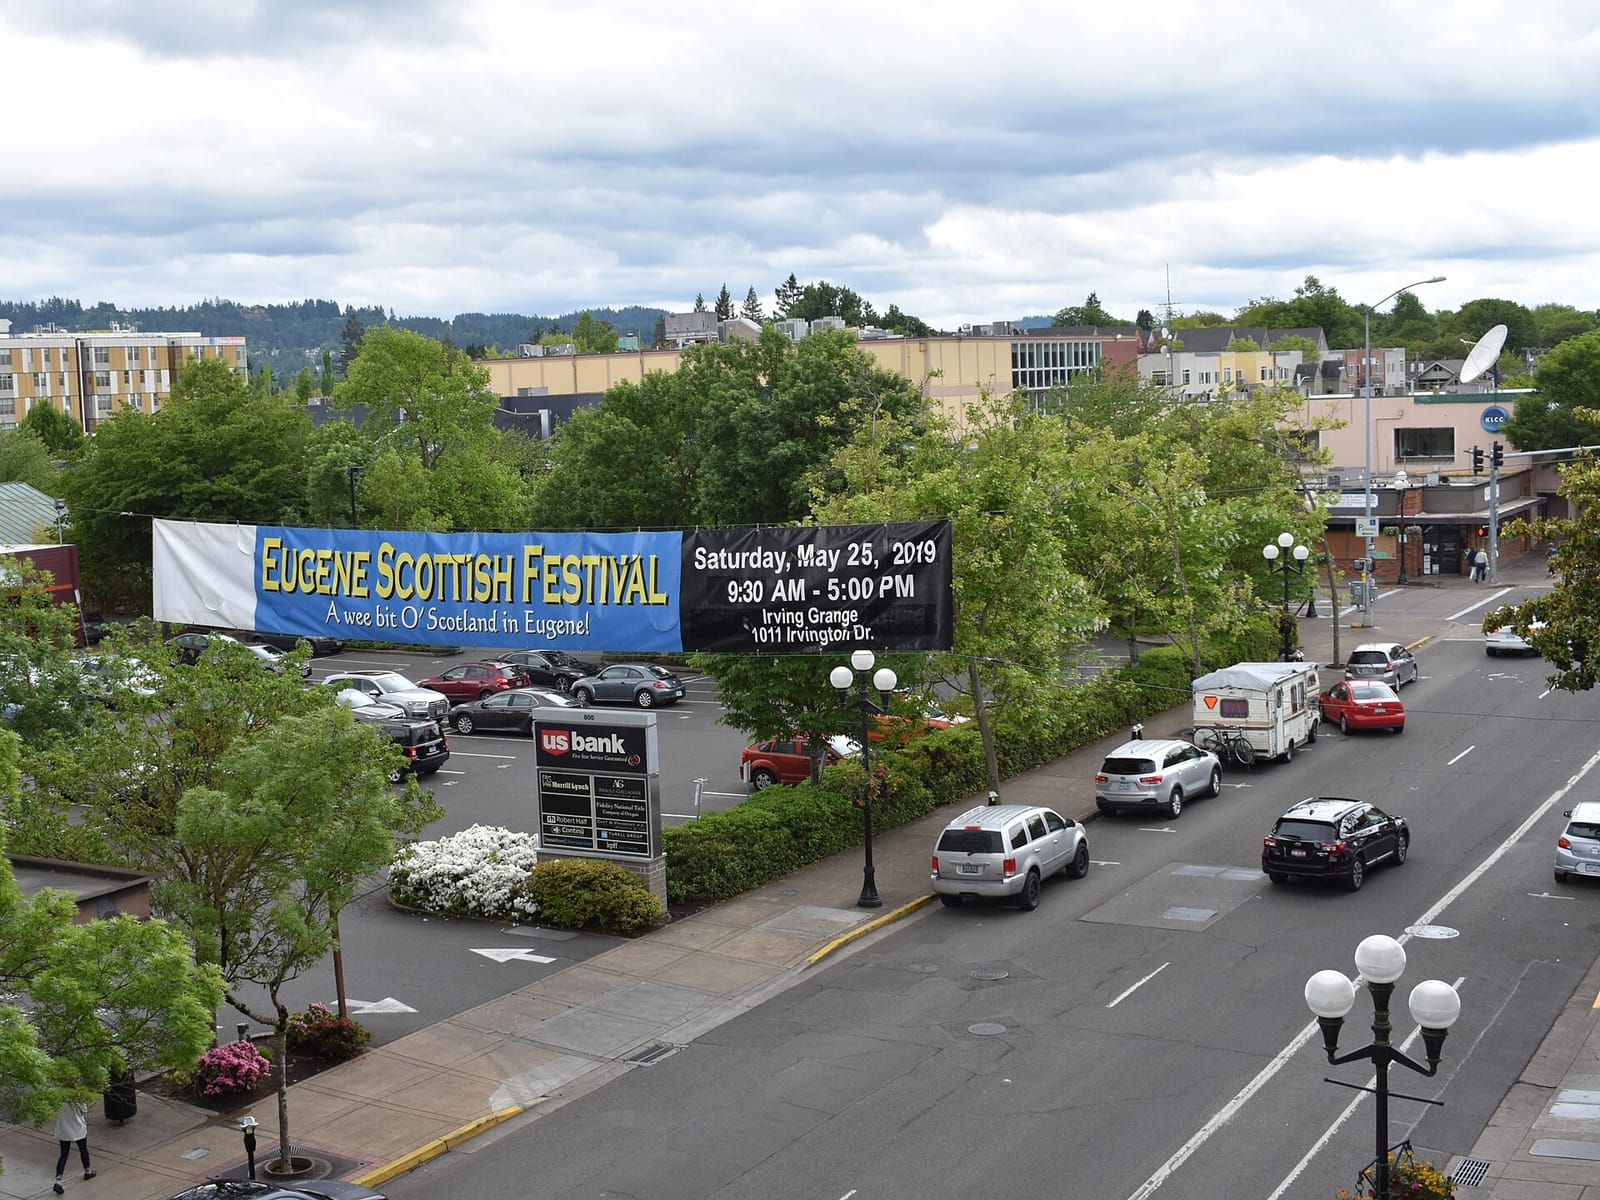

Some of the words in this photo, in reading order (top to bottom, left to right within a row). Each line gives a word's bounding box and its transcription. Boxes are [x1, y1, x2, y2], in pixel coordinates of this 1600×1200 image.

[694, 546, 791, 574] Saturday,
[797, 543, 841, 572] May
[846, 542, 880, 569] 25,
[892, 539, 937, 565] 2019
[727, 580, 764, 603] 9:30
[771, 578, 806, 602] AM
[827, 577, 874, 601] 5:00
[879, 574, 915, 598] PM
[325, 601, 341, 624] A
[343, 611, 372, 627] wee
[376, 604, 399, 629] bit
[502, 611, 520, 633] in
[524, 610, 591, 641] Eugene!
[762, 607, 804, 627] Irving
[808, 606, 859, 628] Grange
[751, 626, 782, 643] 1011
[786, 624, 851, 646] Irvington
[853, 624, 875, 641] Dr.
[571, 731, 626, 754] bank
[552, 781, 571, 789] Merrill
[571, 782, 589, 791] Lynch
[556, 816, 575, 824] Robert
